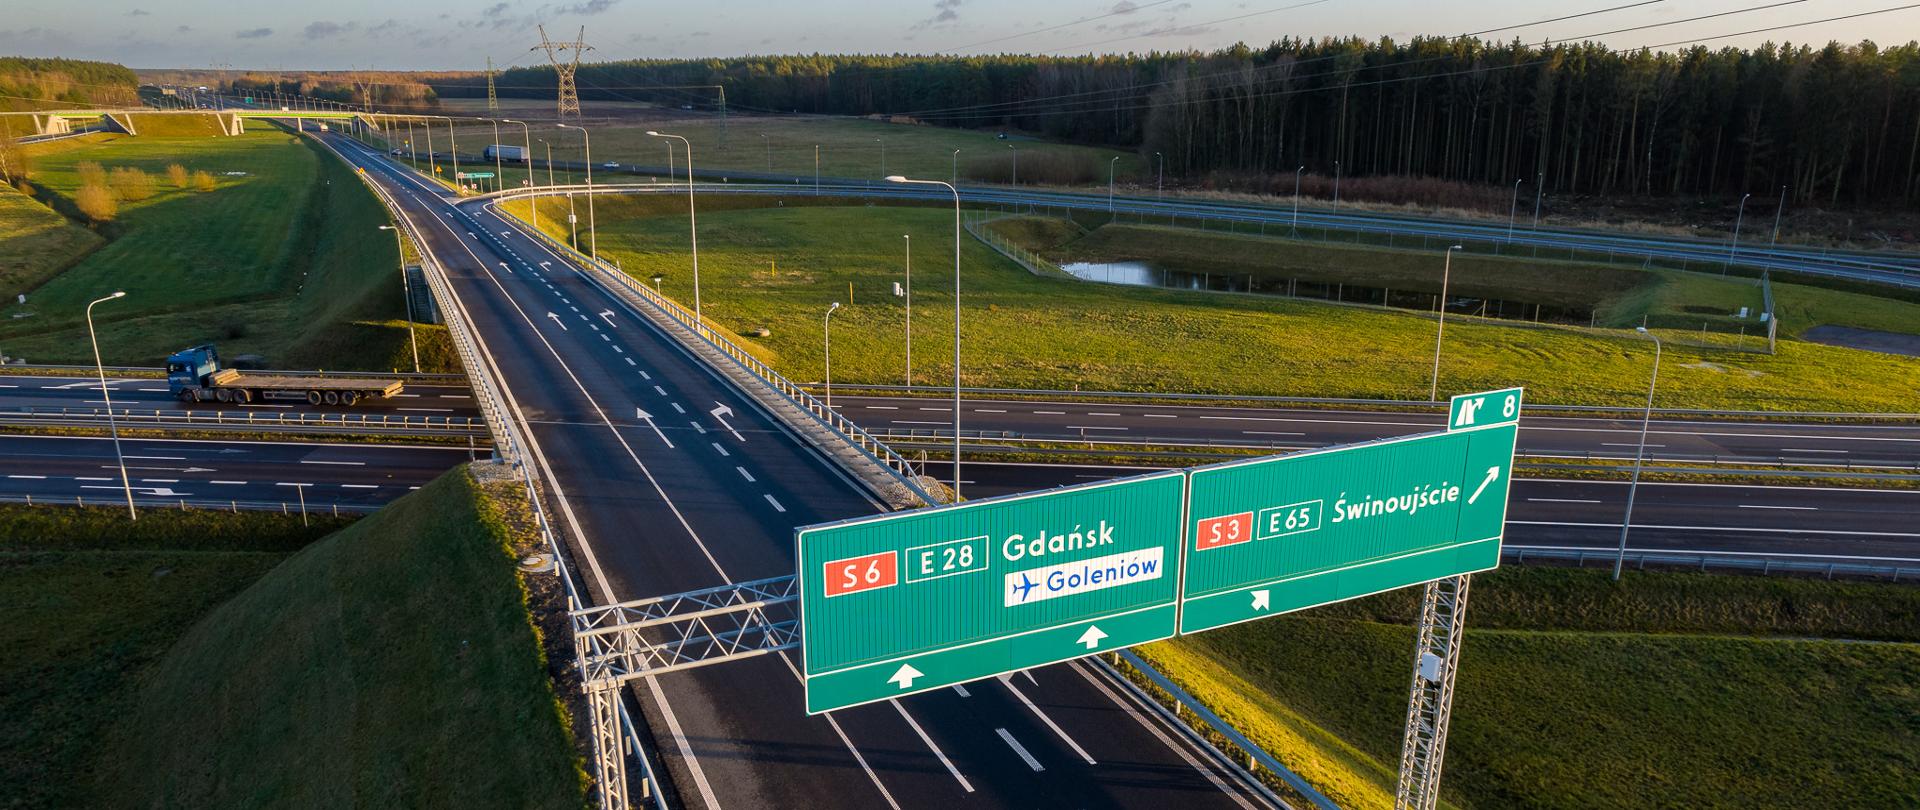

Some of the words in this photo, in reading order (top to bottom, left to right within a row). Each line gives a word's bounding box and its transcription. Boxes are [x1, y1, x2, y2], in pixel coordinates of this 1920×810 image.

[1503, 395, 1515, 417] 8
[1332, 481, 1460, 523] Świnoujście
[1209, 523, 1222, 543] S
[1227, 519, 1239, 539] 3
[1270, 513, 1281, 532] E
[1285, 508, 1310, 528] 65
[1002, 520, 1114, 561] Gdańsk
[921, 551, 934, 574] E
[943, 545, 973, 570] 28
[843, 565, 857, 588] S
[865, 560, 880, 583] 6
[1047, 557, 1157, 591] Goleniów
